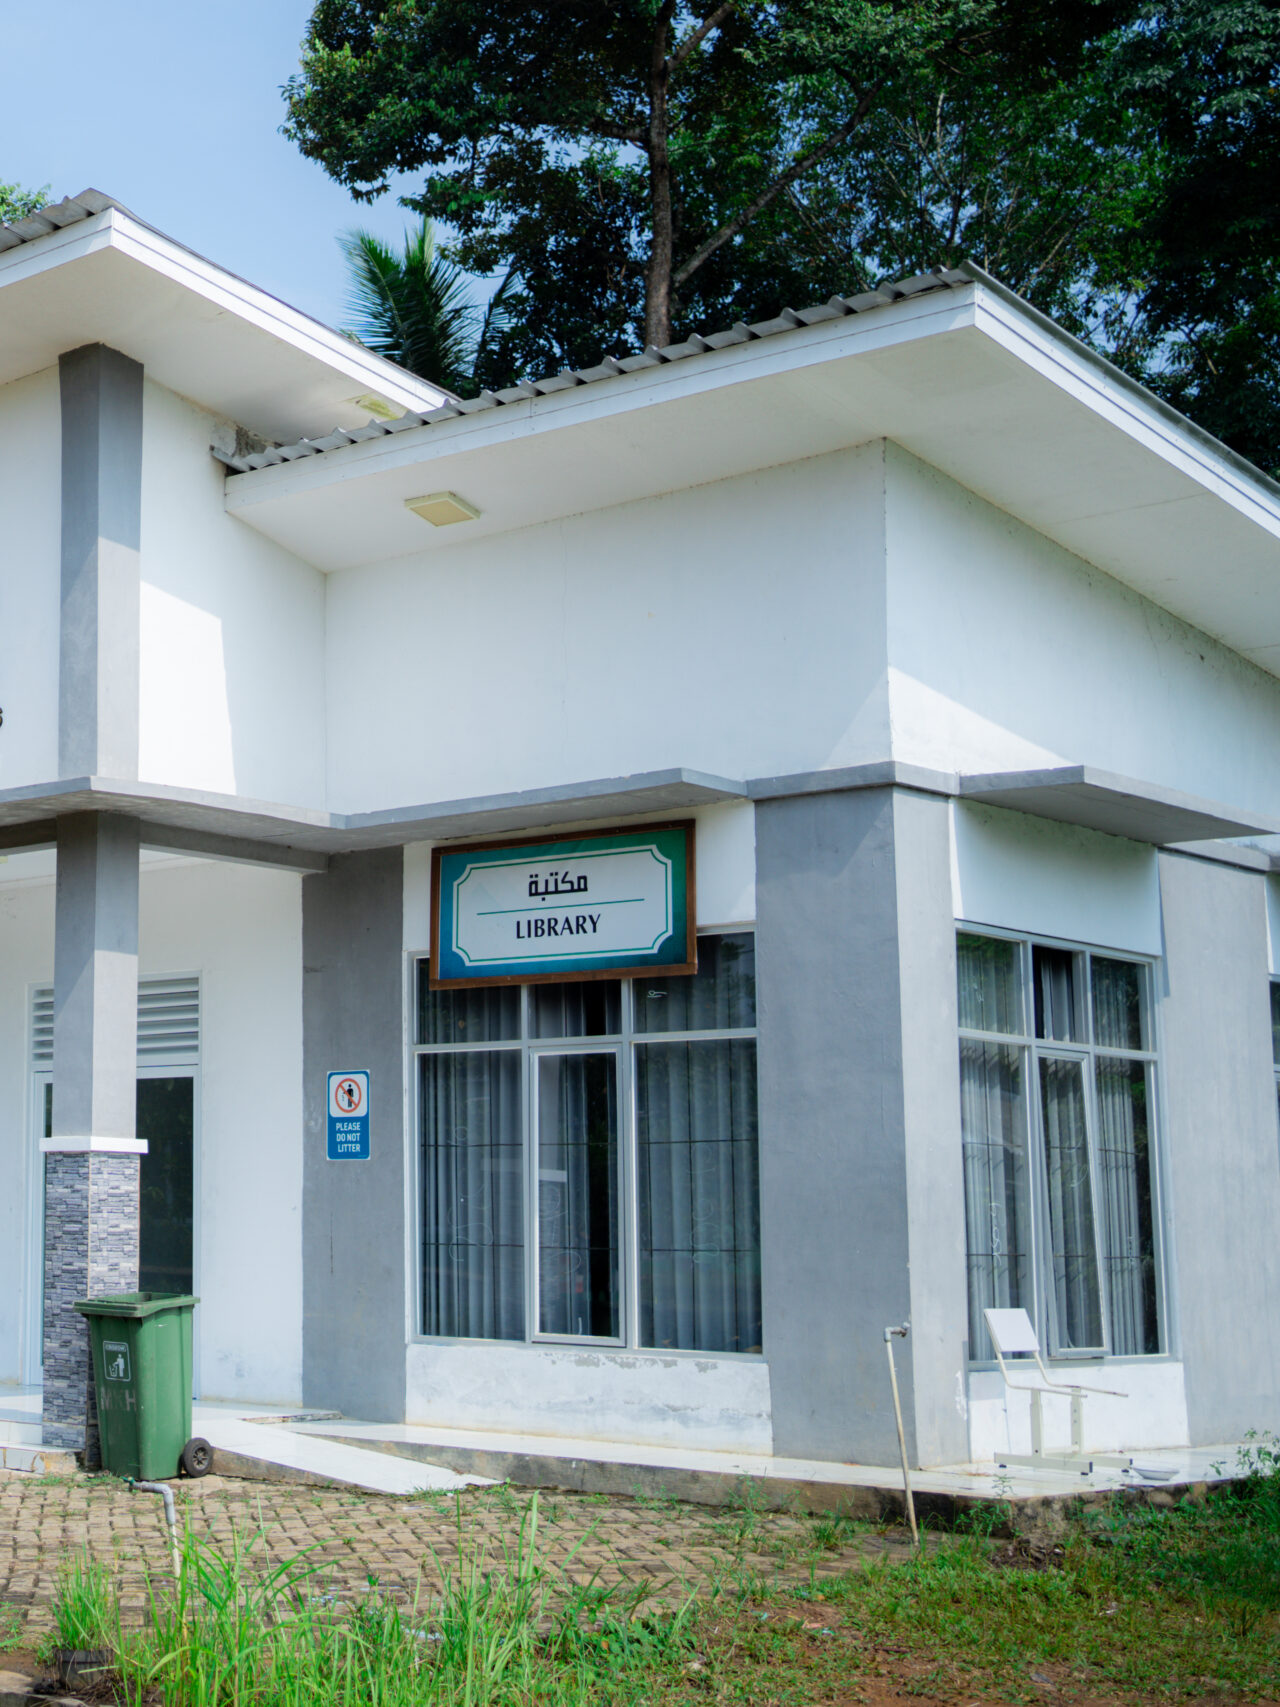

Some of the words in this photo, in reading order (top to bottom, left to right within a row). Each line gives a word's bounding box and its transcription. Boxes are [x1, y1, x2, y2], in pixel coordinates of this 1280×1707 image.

[528, 871, 588, 901] مكتبة
[516, 913, 601, 939] LIBRARY
[336, 1122, 361, 1131] PLEASE
[336, 1133, 346, 1142] DO
[347, 1132, 361, 1142] NOT
[337, 1144, 361, 1153] LITTER
